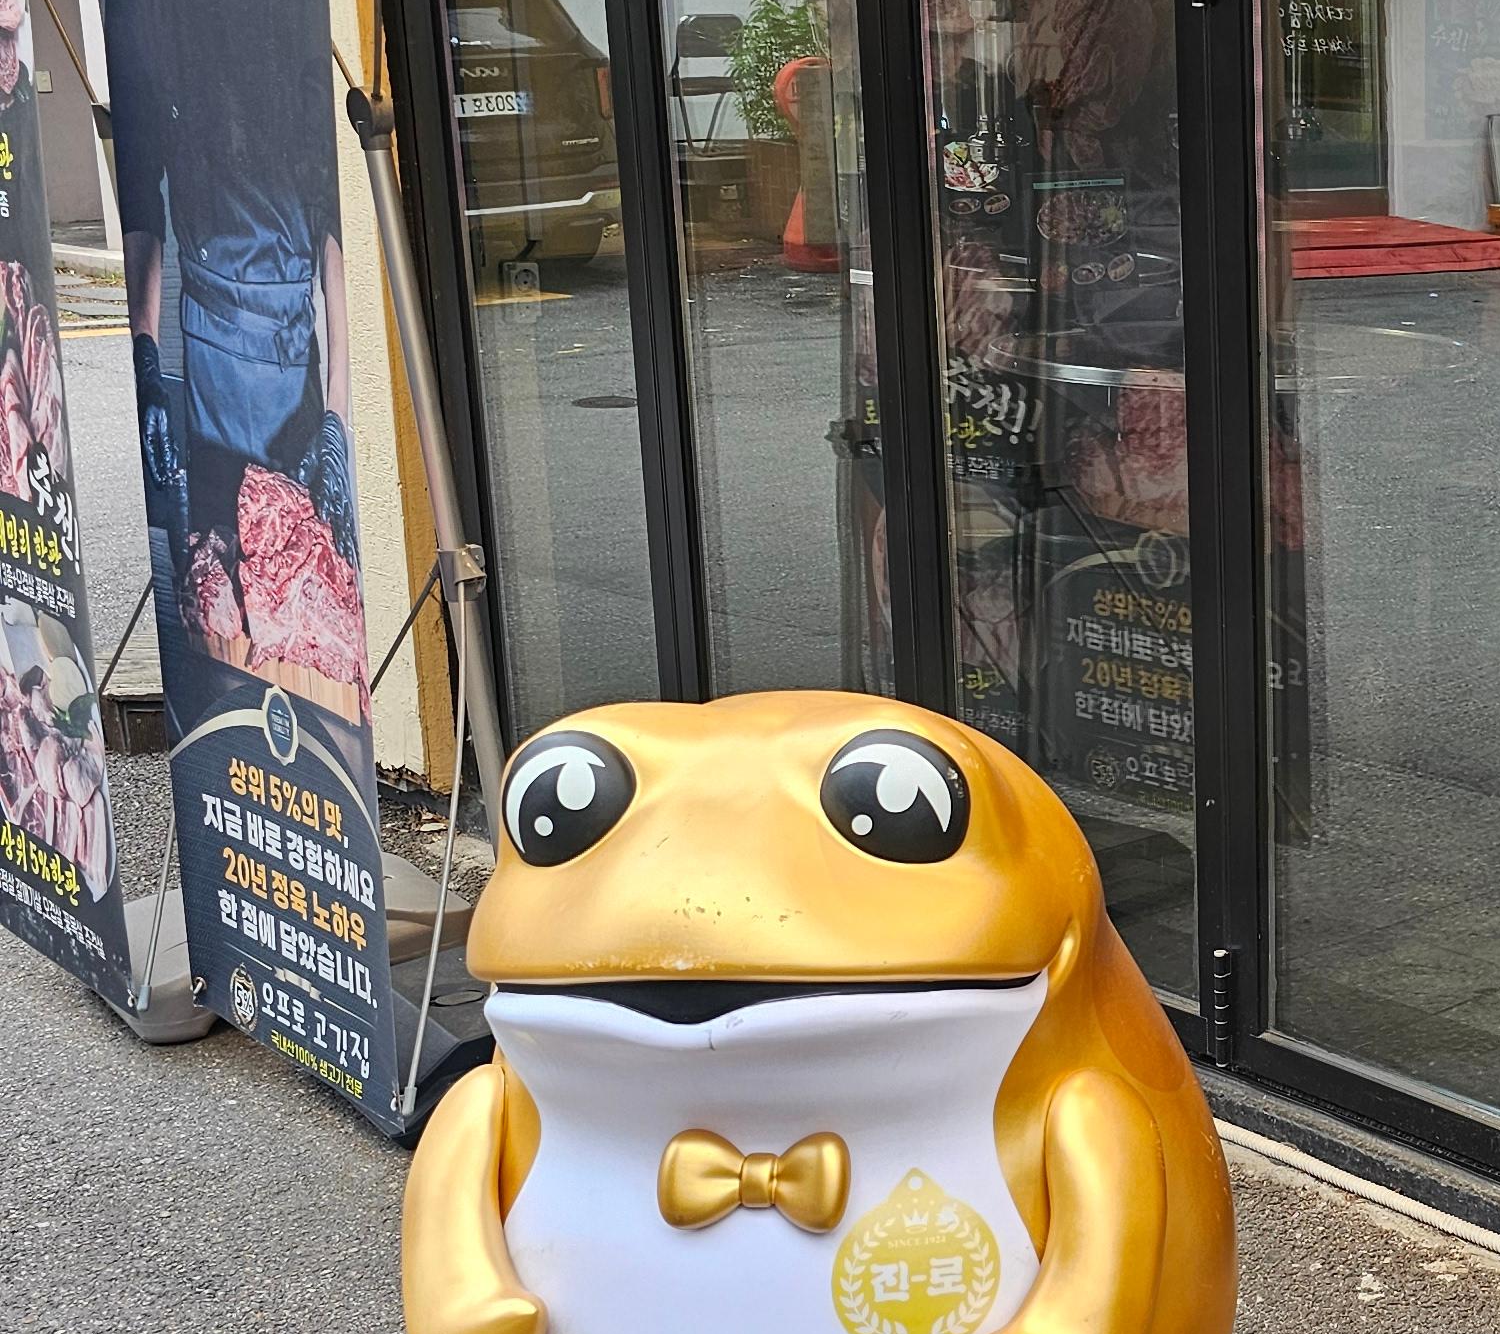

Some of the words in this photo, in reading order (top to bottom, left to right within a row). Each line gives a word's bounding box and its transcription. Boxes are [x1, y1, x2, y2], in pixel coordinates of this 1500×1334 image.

[202, 793, 243, 841] 지금
[246, 811, 283, 860] 바로
[285, 829, 376, 911] 경험하세요
[228, 757, 266, 806] 상위
[269, 775, 320, 832] 5%의
[323, 799, 349, 849] 맛,
[217, 889, 238, 929] 한
[240, 898, 277, 951] 점에
[279, 920, 378, 1009] 담았습니다.
[222, 846, 268, 900] 20년
[271, 869, 308, 921] 정육
[312, 889, 367, 952] 노하우
[261, 982, 307, 1037] 오프로
[313, 1010, 370, 1079] 고깃집
[270, 1029, 318, 1071] 국내산100%
[319, 1058, 344, 1090] 생고기
[345, 1073, 363, 1100] 전문
